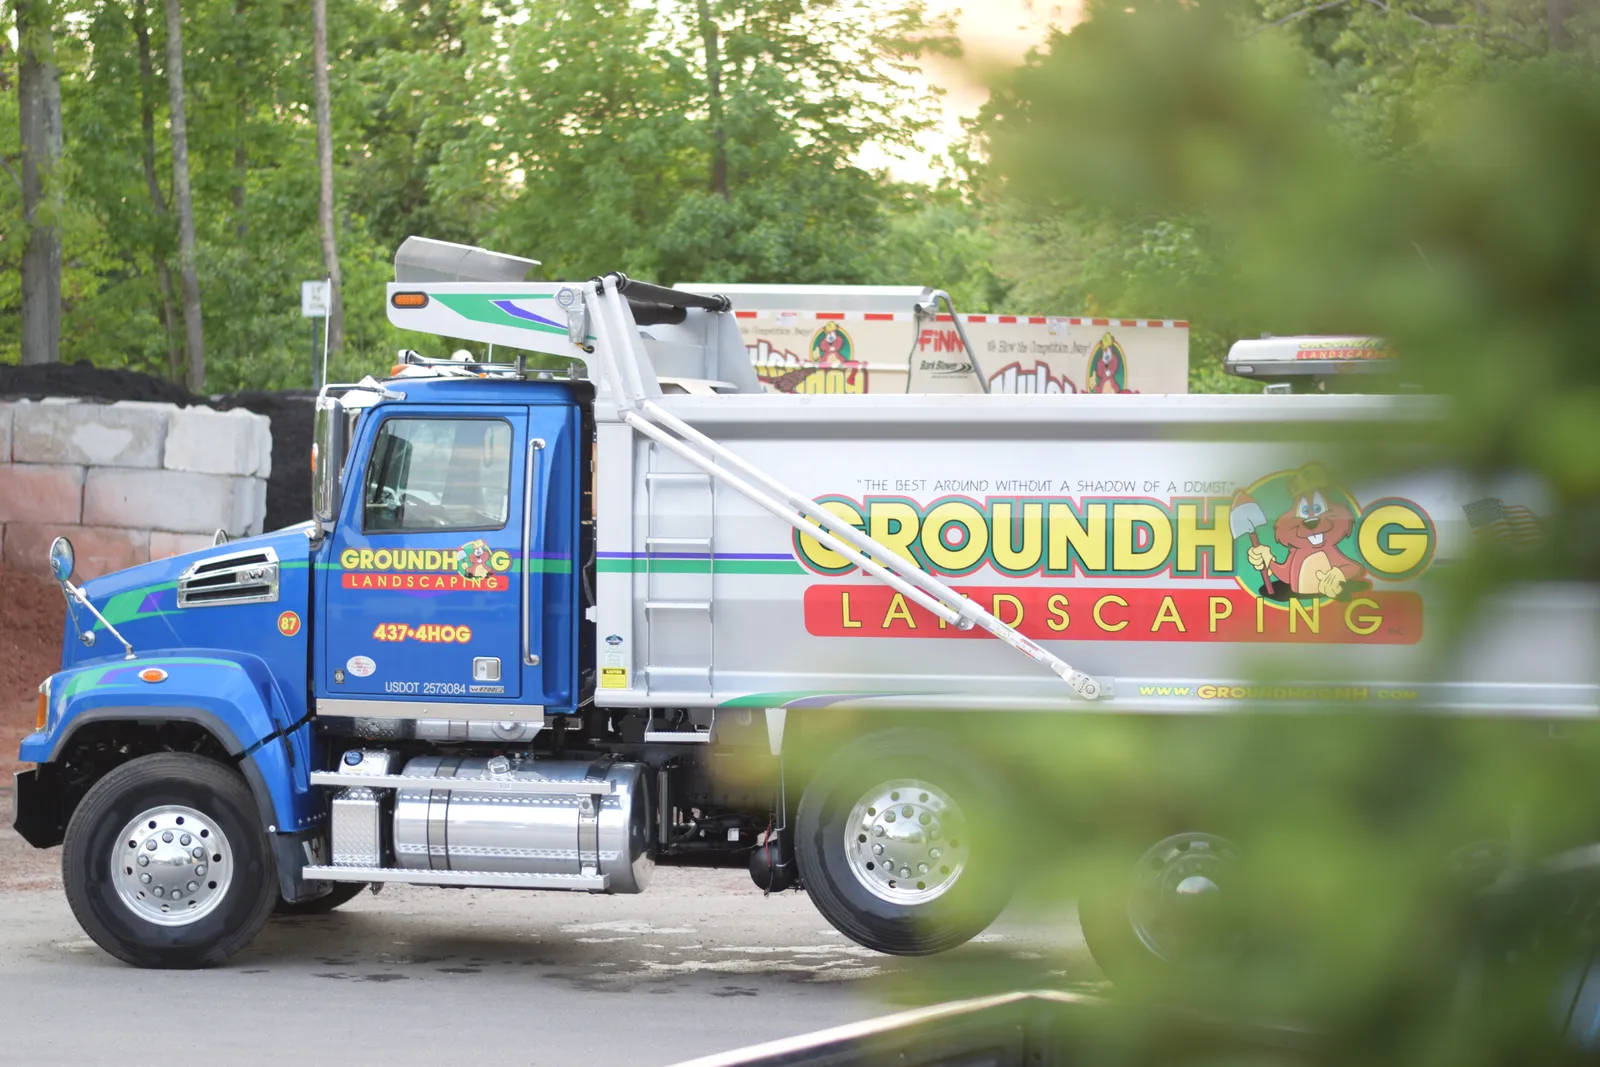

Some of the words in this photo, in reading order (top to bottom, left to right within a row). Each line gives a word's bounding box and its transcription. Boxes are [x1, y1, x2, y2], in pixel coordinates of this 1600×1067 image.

[895, 479, 927, 491] BEST
[934, 479, 989, 492] AROUND
[995, 480, 1053, 492] WITHOUT
[1060, 480, 1070, 492] A
[1076, 480, 1136, 492] SHADOW
[1143, 480, 1160, 492] OF
[1166, 480, 1177, 492] A
[796, 497, 1434, 580] GROUNDHG
[340, 549, 512, 572] GROUNDHG
[352, 576, 498, 589] LANDSCAPING
[281, 617, 296, 630] 87
[385, 682, 420, 693] USDOT
[423, 683, 466, 694] 2573084
